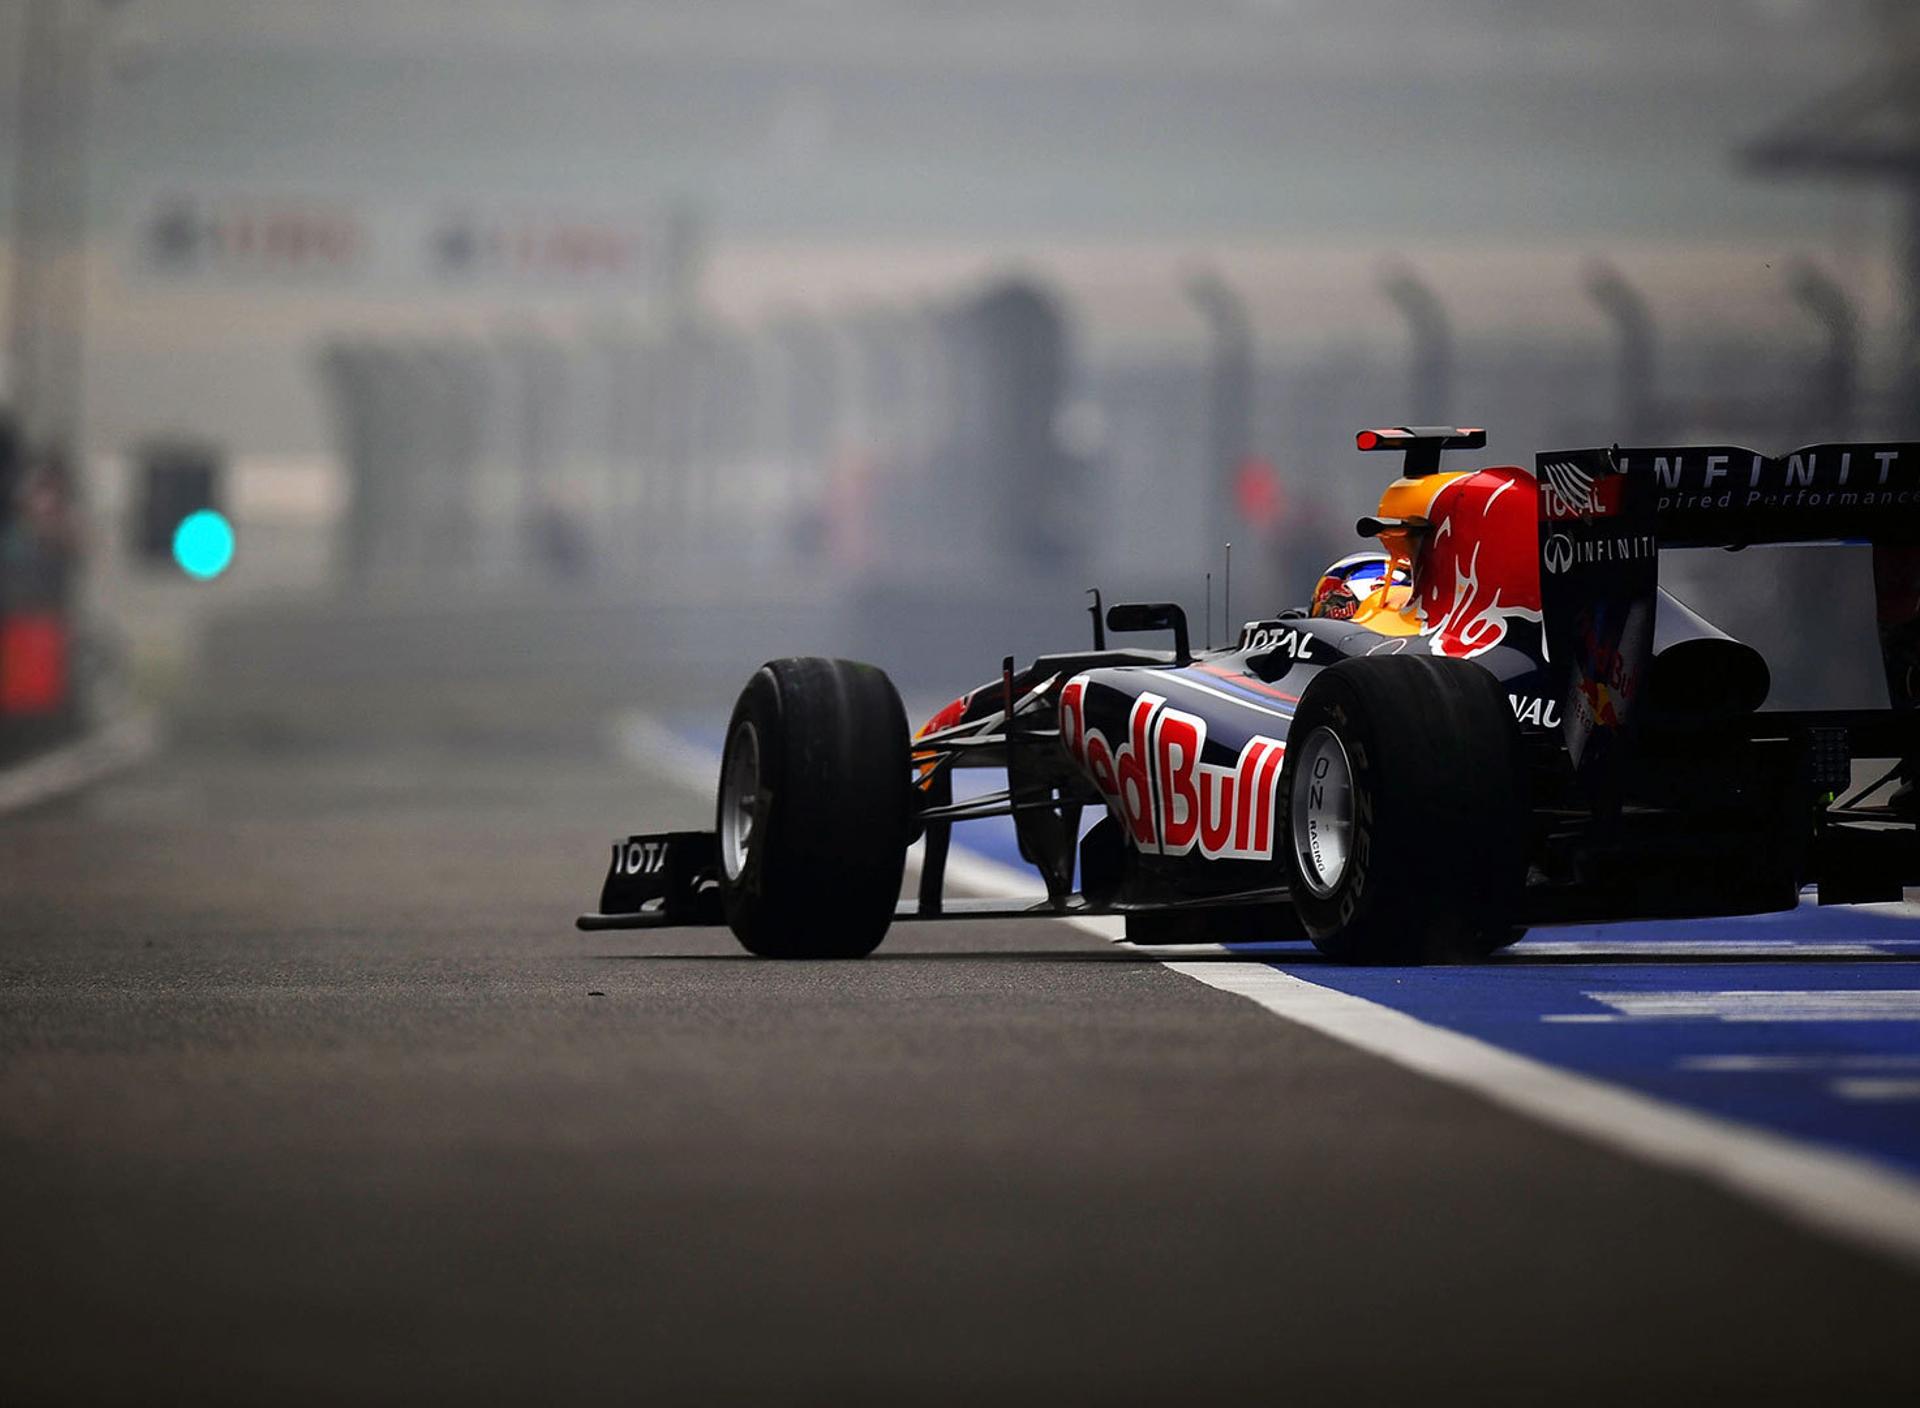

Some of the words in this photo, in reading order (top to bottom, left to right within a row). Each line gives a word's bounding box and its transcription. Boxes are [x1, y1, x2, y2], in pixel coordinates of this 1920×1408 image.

[1540, 484, 1607, 517] TOAL
[1577, 536, 1656, 563] INFINITI
[1241, 622, 1314, 659] TOTAL
[1155, 707, 1287, 861] Bull
[1309, 820, 1326, 872] RACING
